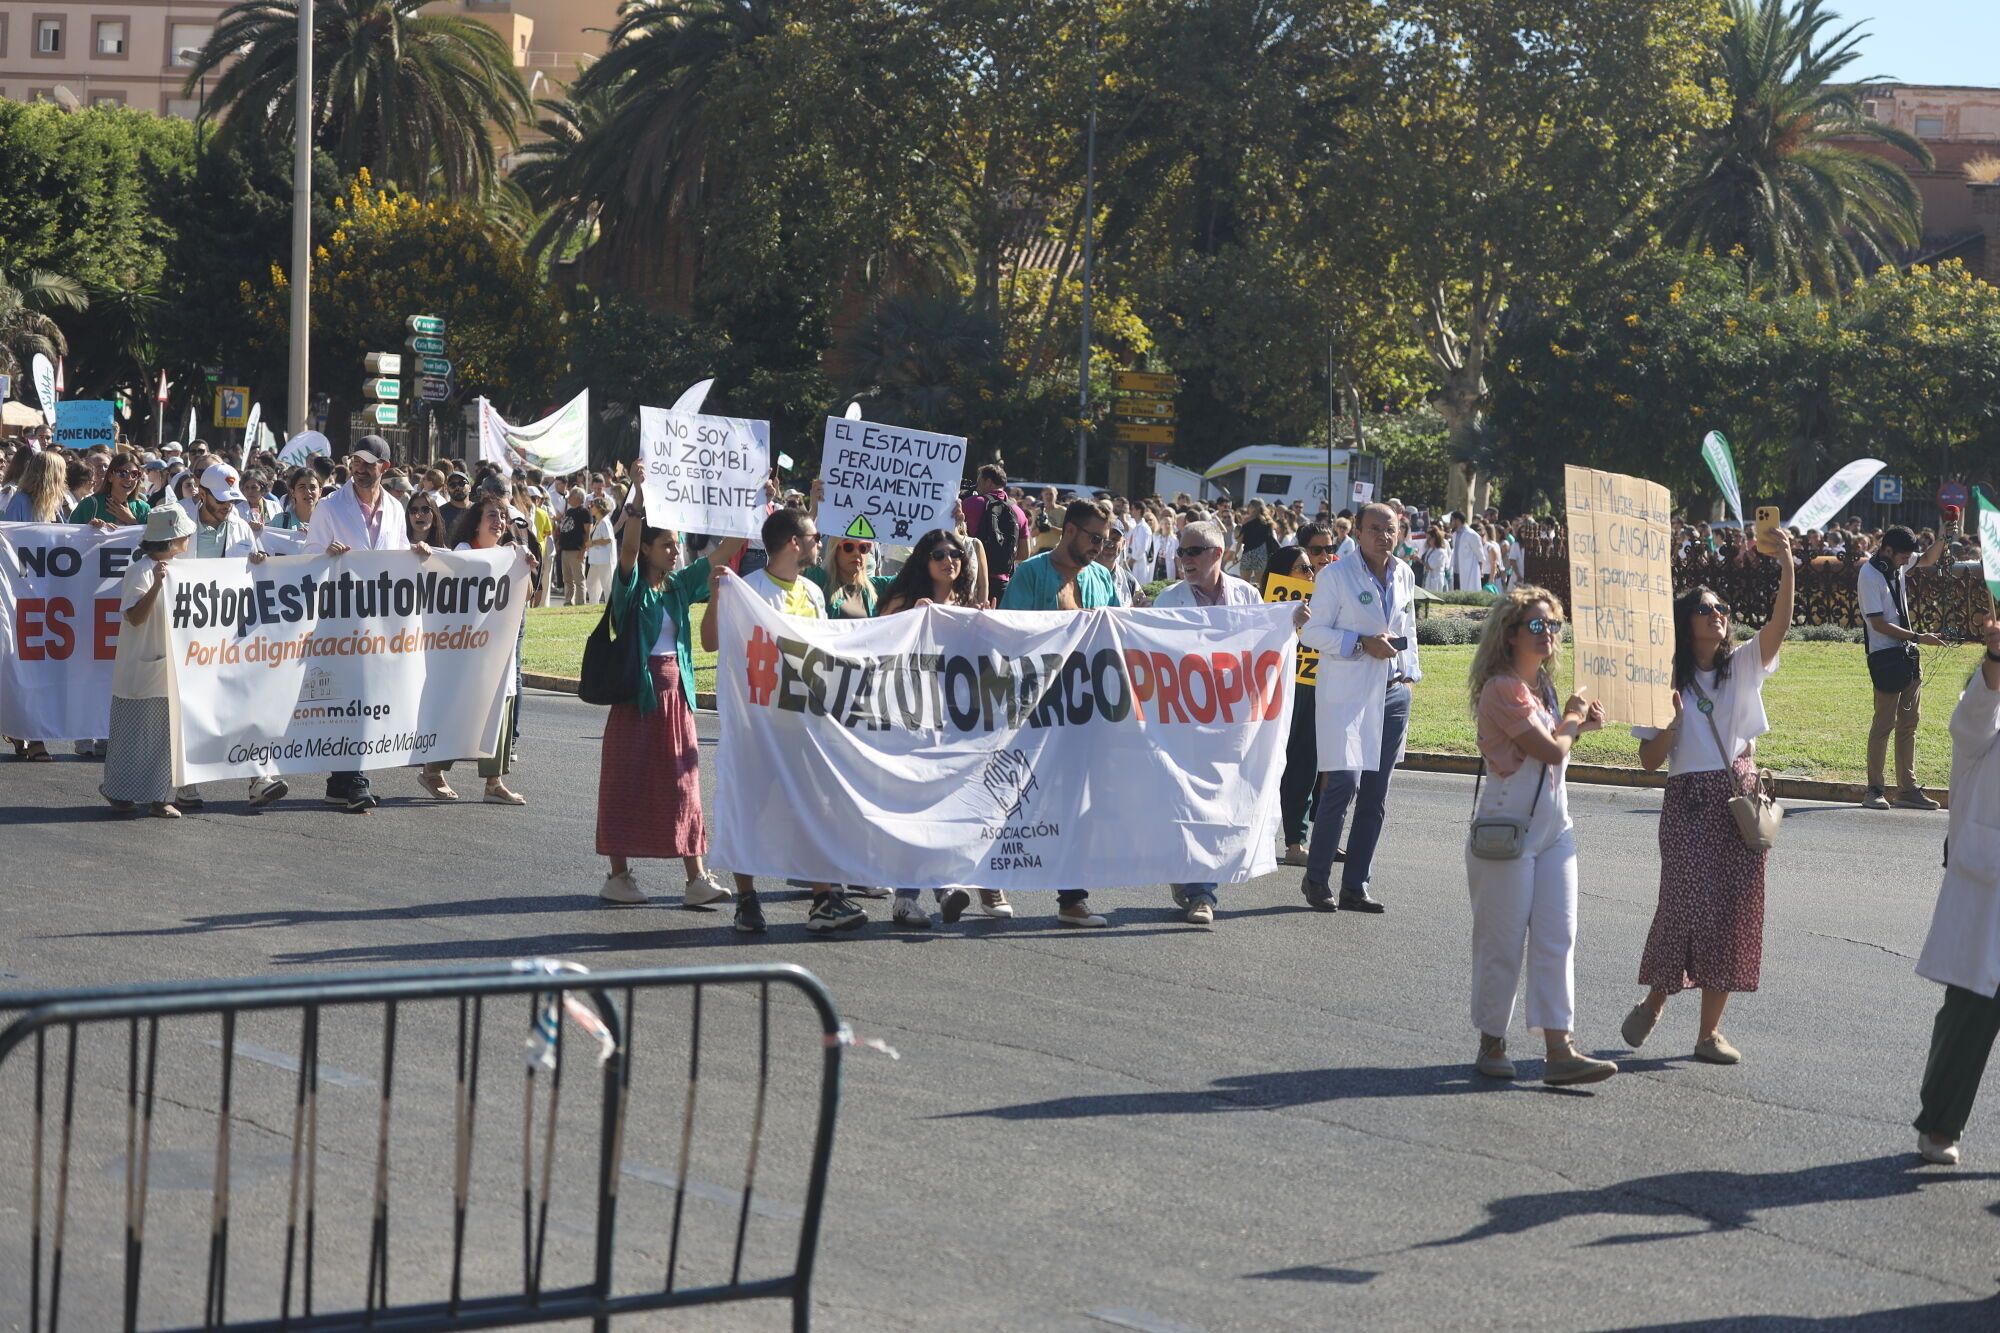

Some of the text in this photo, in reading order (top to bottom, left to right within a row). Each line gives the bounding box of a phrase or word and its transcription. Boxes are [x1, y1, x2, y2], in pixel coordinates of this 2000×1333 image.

[56, 428, 112, 441] FONENDOS
[654, 441, 672, 457] UN
[697, 426, 729, 446] SOY
[835, 424, 962, 463] EL ESTATUTO
[650, 461, 722, 480] SOLO ESTOY
[839, 449, 932, 479] PERJUDICA
[665, 480, 757, 508] SALIENTE
[827, 468, 944, 500] SERIAMENTE
[834, 492, 934, 521] LA SALUD
[1608, 523, 1667, 564] CANSADA
[18, 547, 82, 578] NO
[1576, 567, 1589, 588] DE
[173, 570, 511, 638] #StopEstatutoMarco
[16, 596, 76, 660] ES
[1577, 605, 1666, 646] TRAJE 60
[185, 639, 217, 666] Por
[219, 638, 240, 665] la
[244, 629, 385, 669] dignificación
[421, 624, 489, 651] médico
[747, 624, 1283, 732] #ESTATUTOMARCOPROPIO
[1583, 651, 1618, 677] HORAS
[293, 700, 390, 720] commálaga
[228, 730, 437, 766] Colegio de Médicos de Málaga
[980, 821, 1060, 840] ASOCIACIÓN
[990, 853, 1043, 871] ESPAÑA
[1001, 841, 1025, 856] MIR
